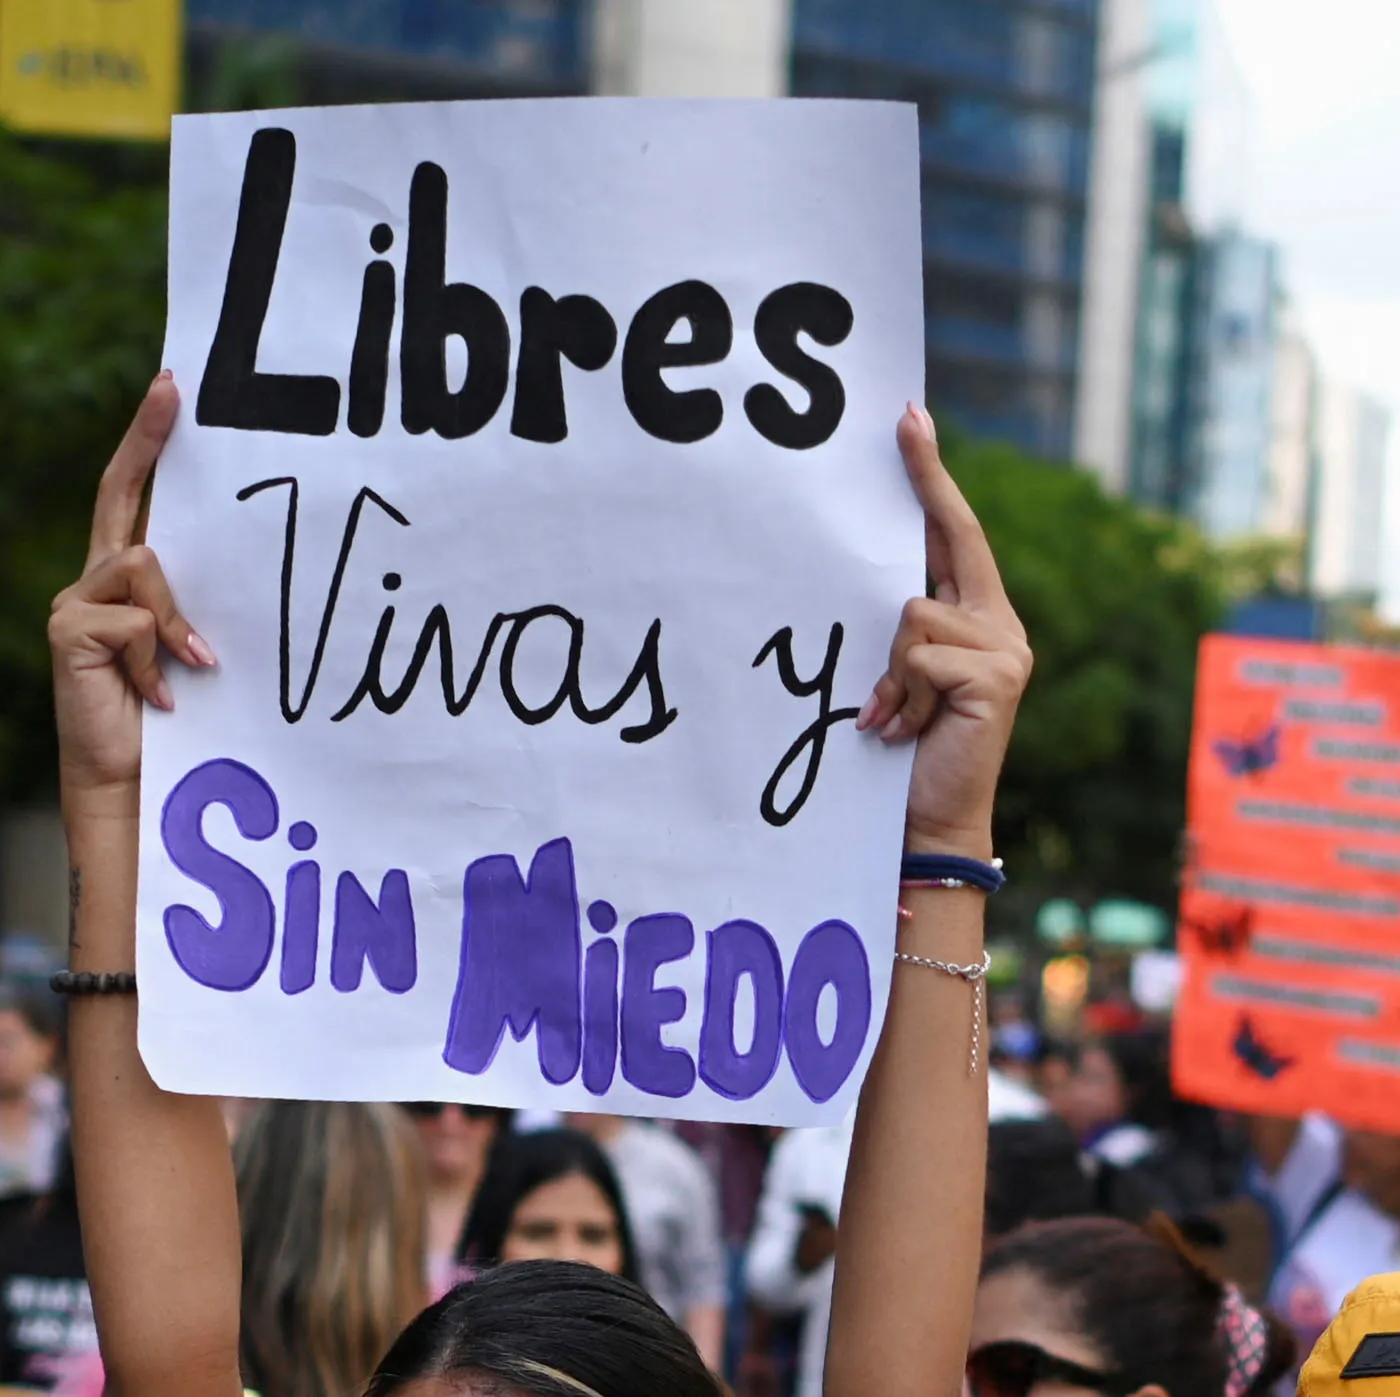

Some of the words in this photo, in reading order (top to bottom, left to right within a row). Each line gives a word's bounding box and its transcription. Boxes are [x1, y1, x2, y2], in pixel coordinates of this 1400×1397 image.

[195, 127, 855, 451] Libres
[235, 475, 680, 745] Vivas
[750, 620, 862, 828] y
